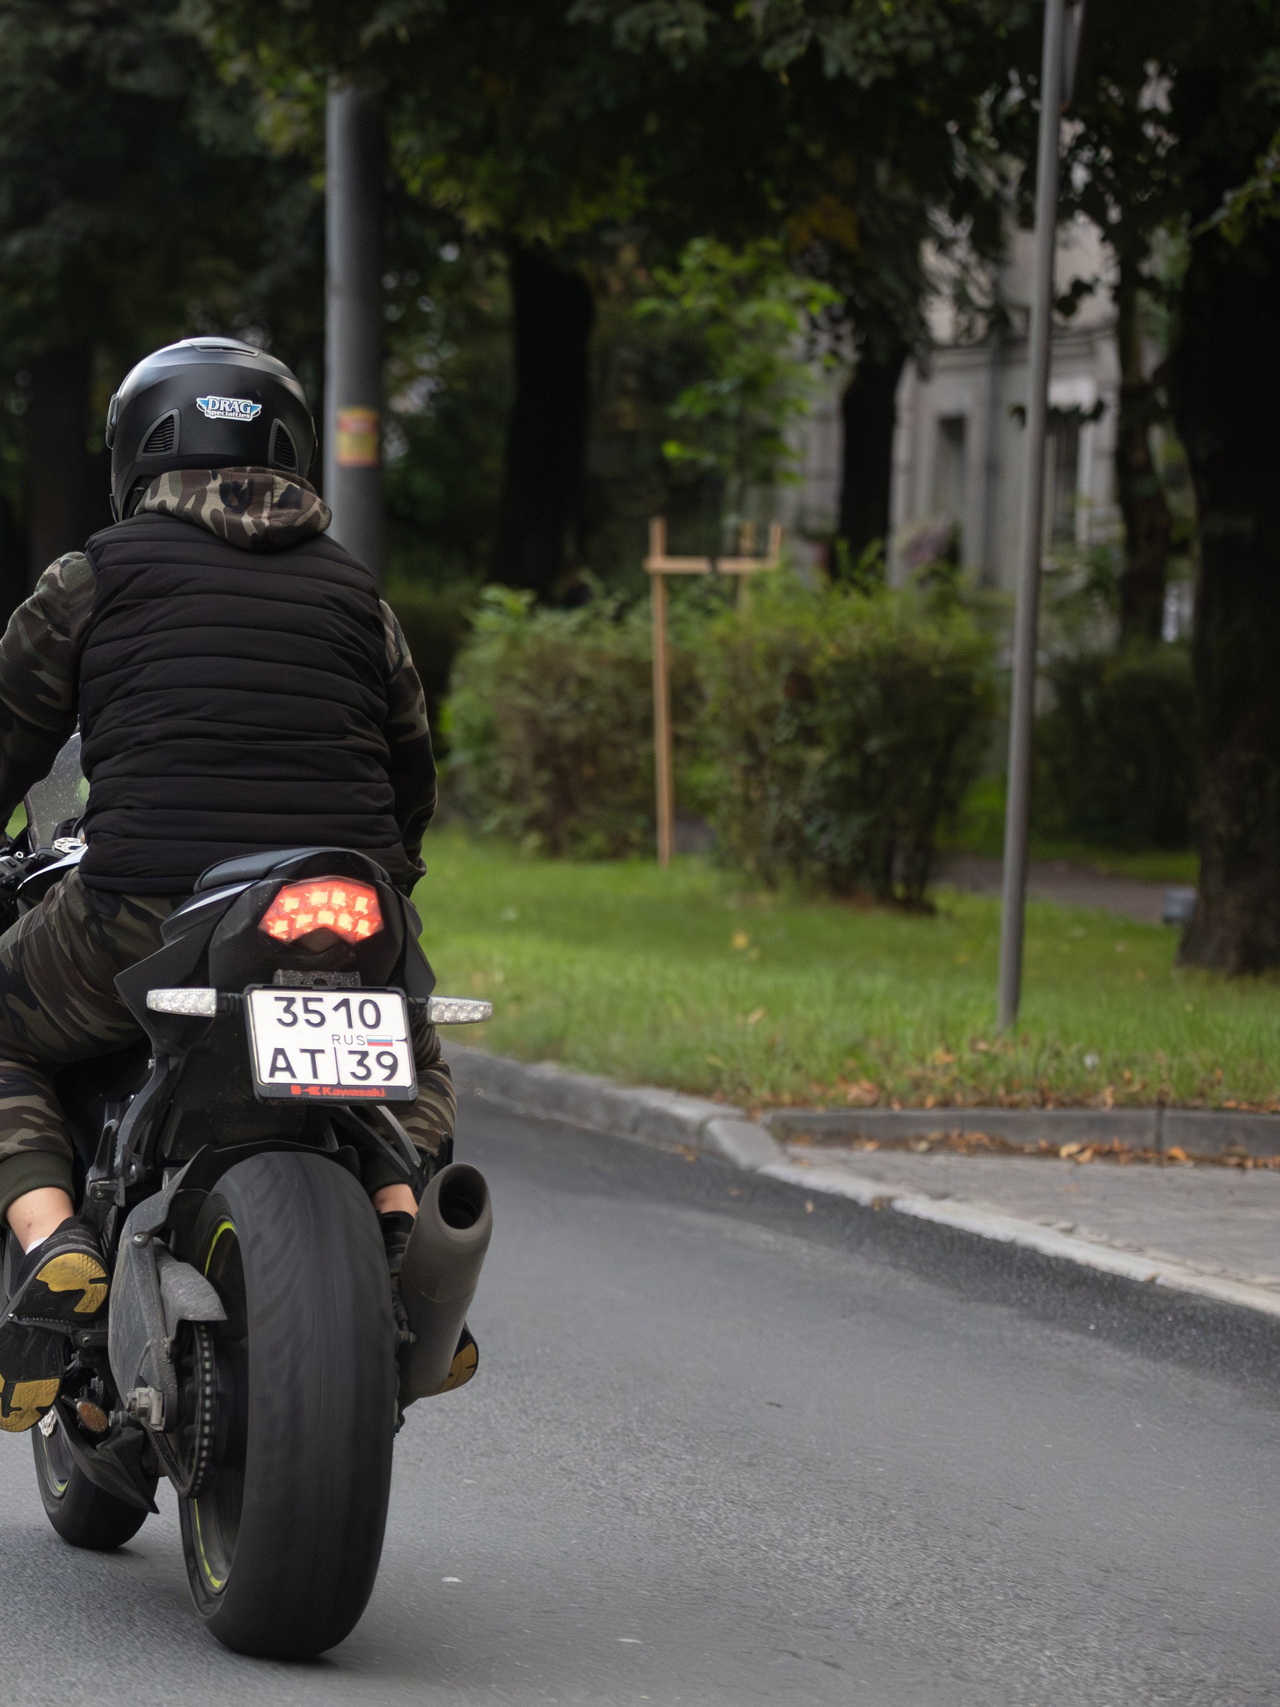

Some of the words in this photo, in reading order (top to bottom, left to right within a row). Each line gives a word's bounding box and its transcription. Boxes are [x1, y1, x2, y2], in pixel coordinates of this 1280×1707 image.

[207, 398, 251, 414] DRAG
[273, 996, 382, 1030] 3510
[331, 1034, 366, 1046] RUS
[268, 1047, 326, 1080] AT
[347, 1050, 399, 1082] 39
[322, 1086, 386, 1098] Kawasaki
